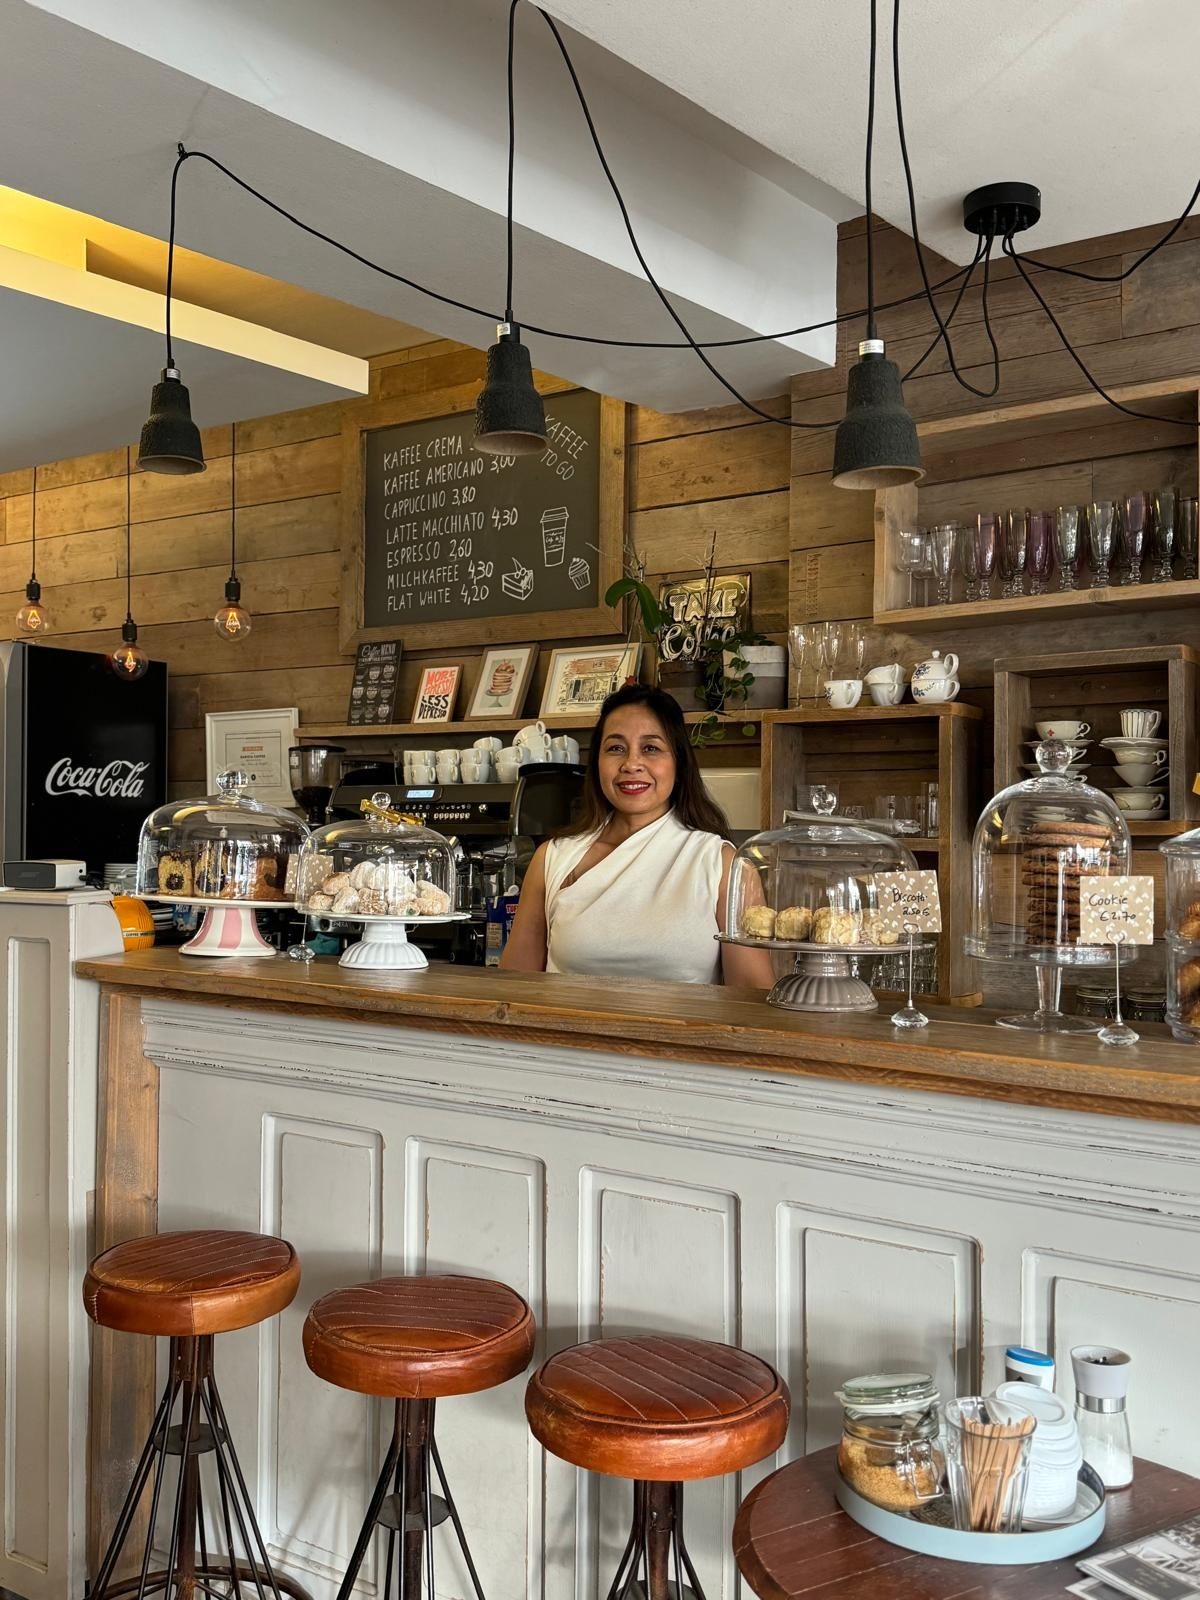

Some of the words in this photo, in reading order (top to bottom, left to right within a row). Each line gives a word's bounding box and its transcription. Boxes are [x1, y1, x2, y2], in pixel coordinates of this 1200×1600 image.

[383, 444, 422, 471] KAFFEE
[426, 435, 463, 458] CREMA
[540, 448, 558, 467] TO
[555, 460, 575, 481] GO
[384, 469, 421, 496] KAFFEE
[425, 457, 484, 486] AMERICANO
[384, 490, 446, 520] CAPPUCCINO
[451, 485, 476, 506] 3,80
[386, 522, 418, 545] LATTE
[422, 511, 485, 538] MACCHIATO
[491, 507, 519, 531] 4,30
[386, 541, 440, 569] ESPRESSO
[387, 564, 460, 590] MILCHKAFFEE
[468, 560, 494, 585] 4,30
[387, 592, 413, 612] FLAT
[419, 587, 451, 606] WHITE
[460, 584, 489, 605] 4,20
[669, 588, 738, 622] TAKE
[421, 694, 449, 709] LESS
[45, 757, 150, 797] Coca-Cola
[1088, 892, 1128, 907] Cookie
